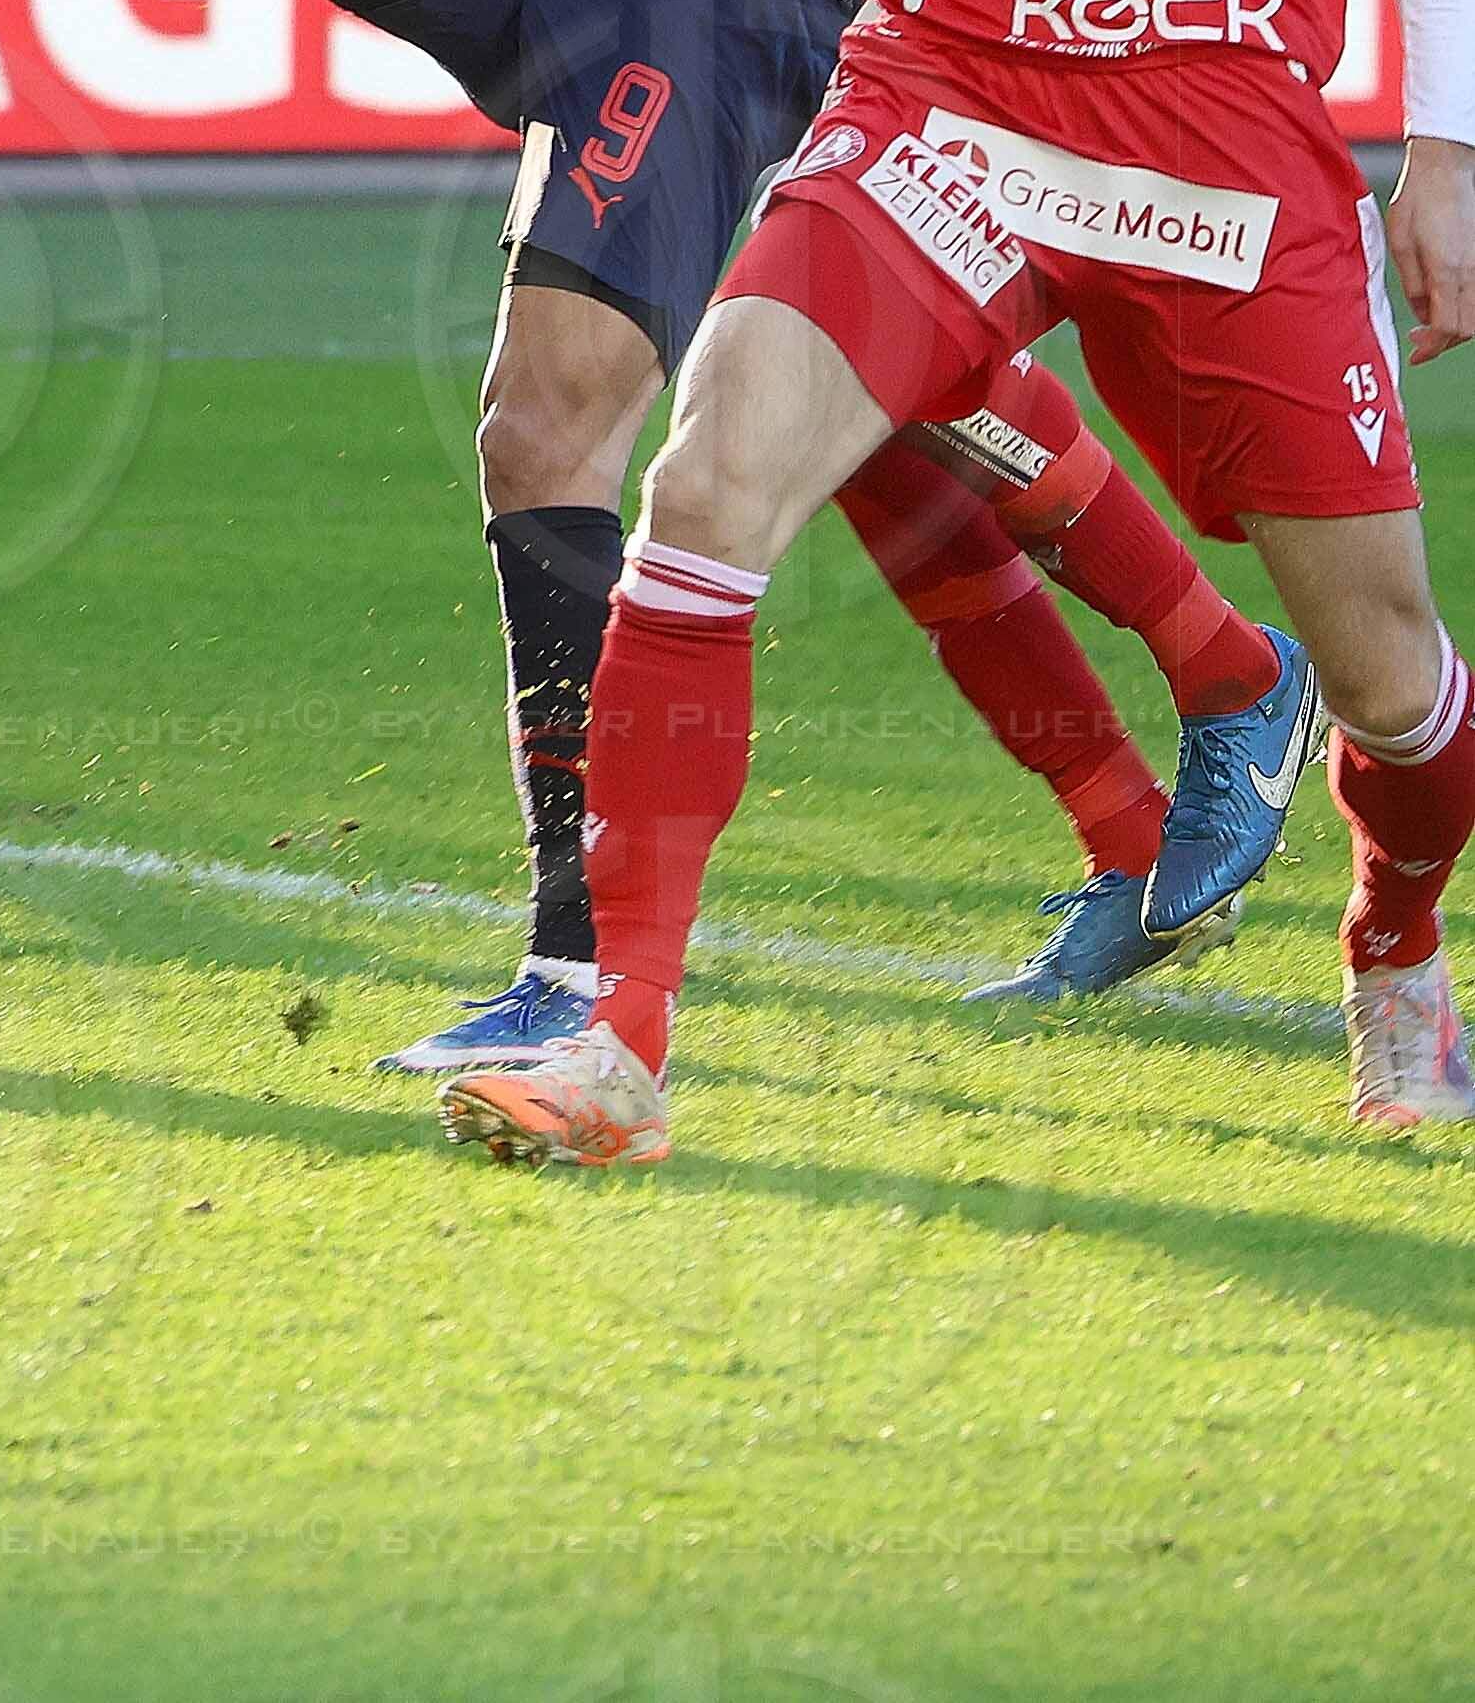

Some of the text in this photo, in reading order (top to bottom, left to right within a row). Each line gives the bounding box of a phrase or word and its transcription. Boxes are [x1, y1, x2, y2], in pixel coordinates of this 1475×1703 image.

[580, 60, 675, 184] 9
[871, 169, 1002, 290] ZEITUNG
[892, 145, 1020, 266] KLEINE
[999, 167, 1247, 263] GrazMobil
[1342, 362, 1379, 403] 15
